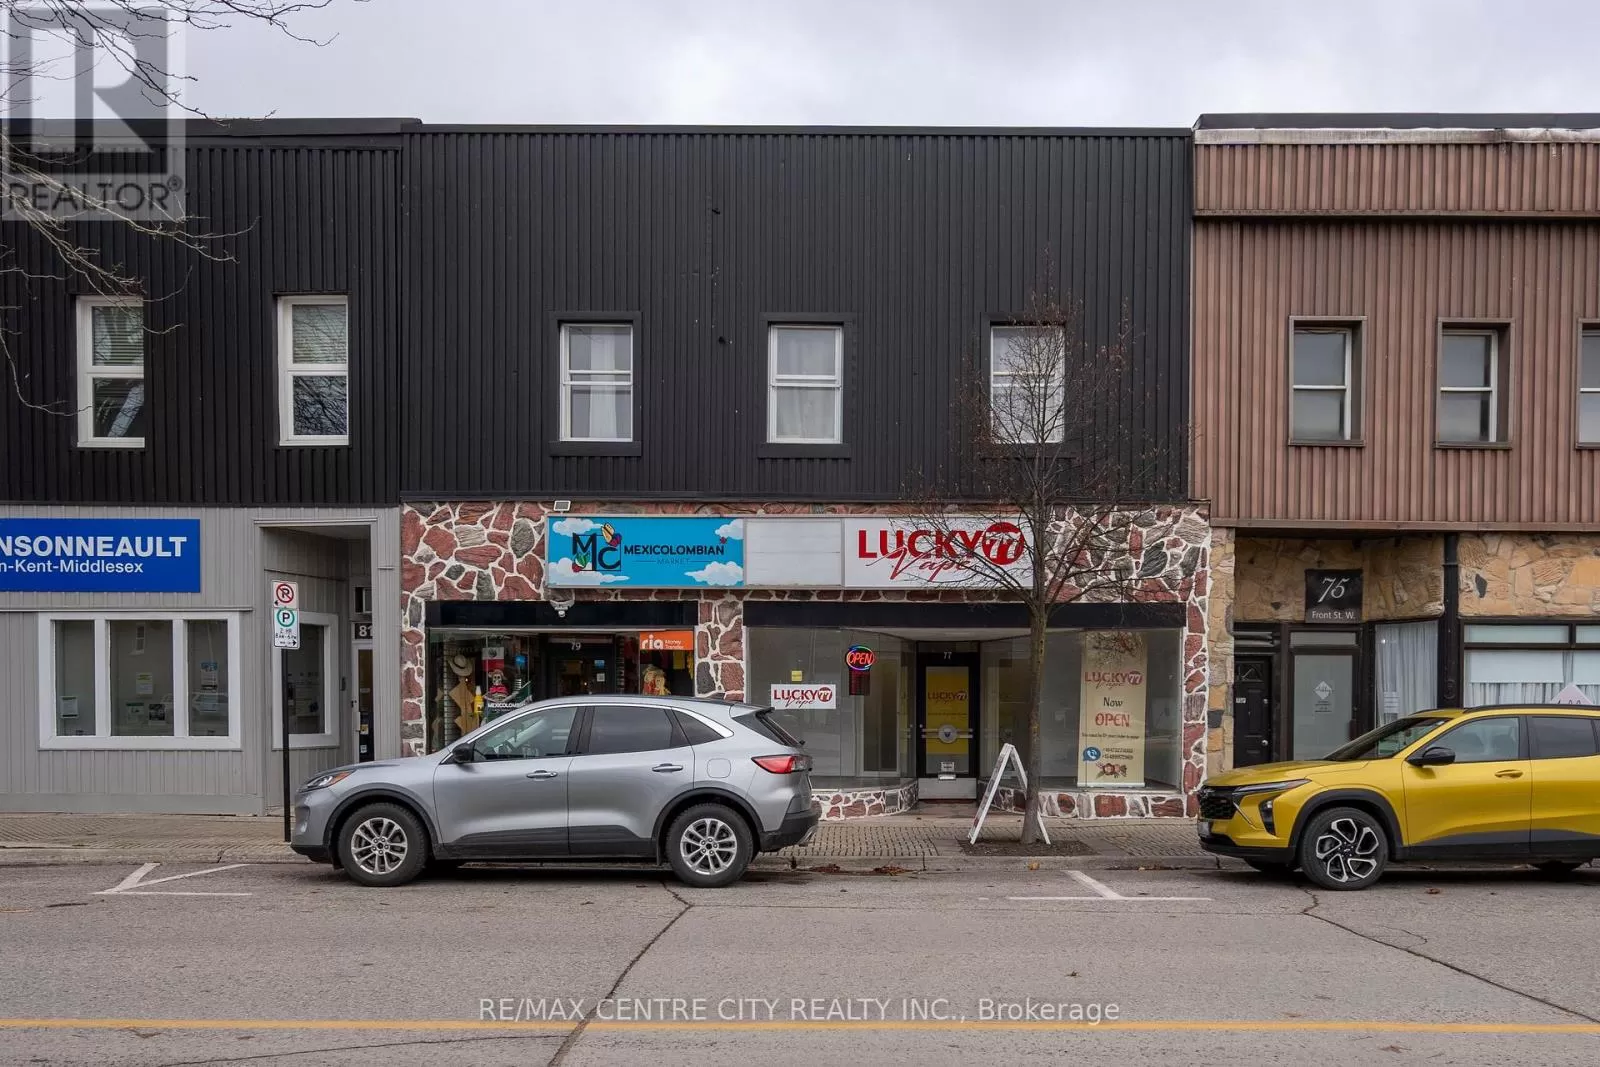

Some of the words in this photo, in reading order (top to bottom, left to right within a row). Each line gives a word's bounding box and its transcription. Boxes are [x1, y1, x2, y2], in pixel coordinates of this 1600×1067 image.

[623, 544, 725, 556] MEXICOLOMBIAN
[866, 546, 971, 582] Vape
[1317, 577, 1351, 603] 75
[1311, 610, 1332, 620] Front
[571, 641, 582, 651] 79
[641, 634, 664, 650] ria
[848, 652, 873, 665] OPEN
[943, 652, 953, 660] 77
[1084, 671, 1128, 683] LUCKY
[773, 689, 818, 700] LUCKY
[776, 695, 817, 708] Vape
[1103, 697, 1123, 707] Now
[1095, 713, 1130, 727] OPEN
